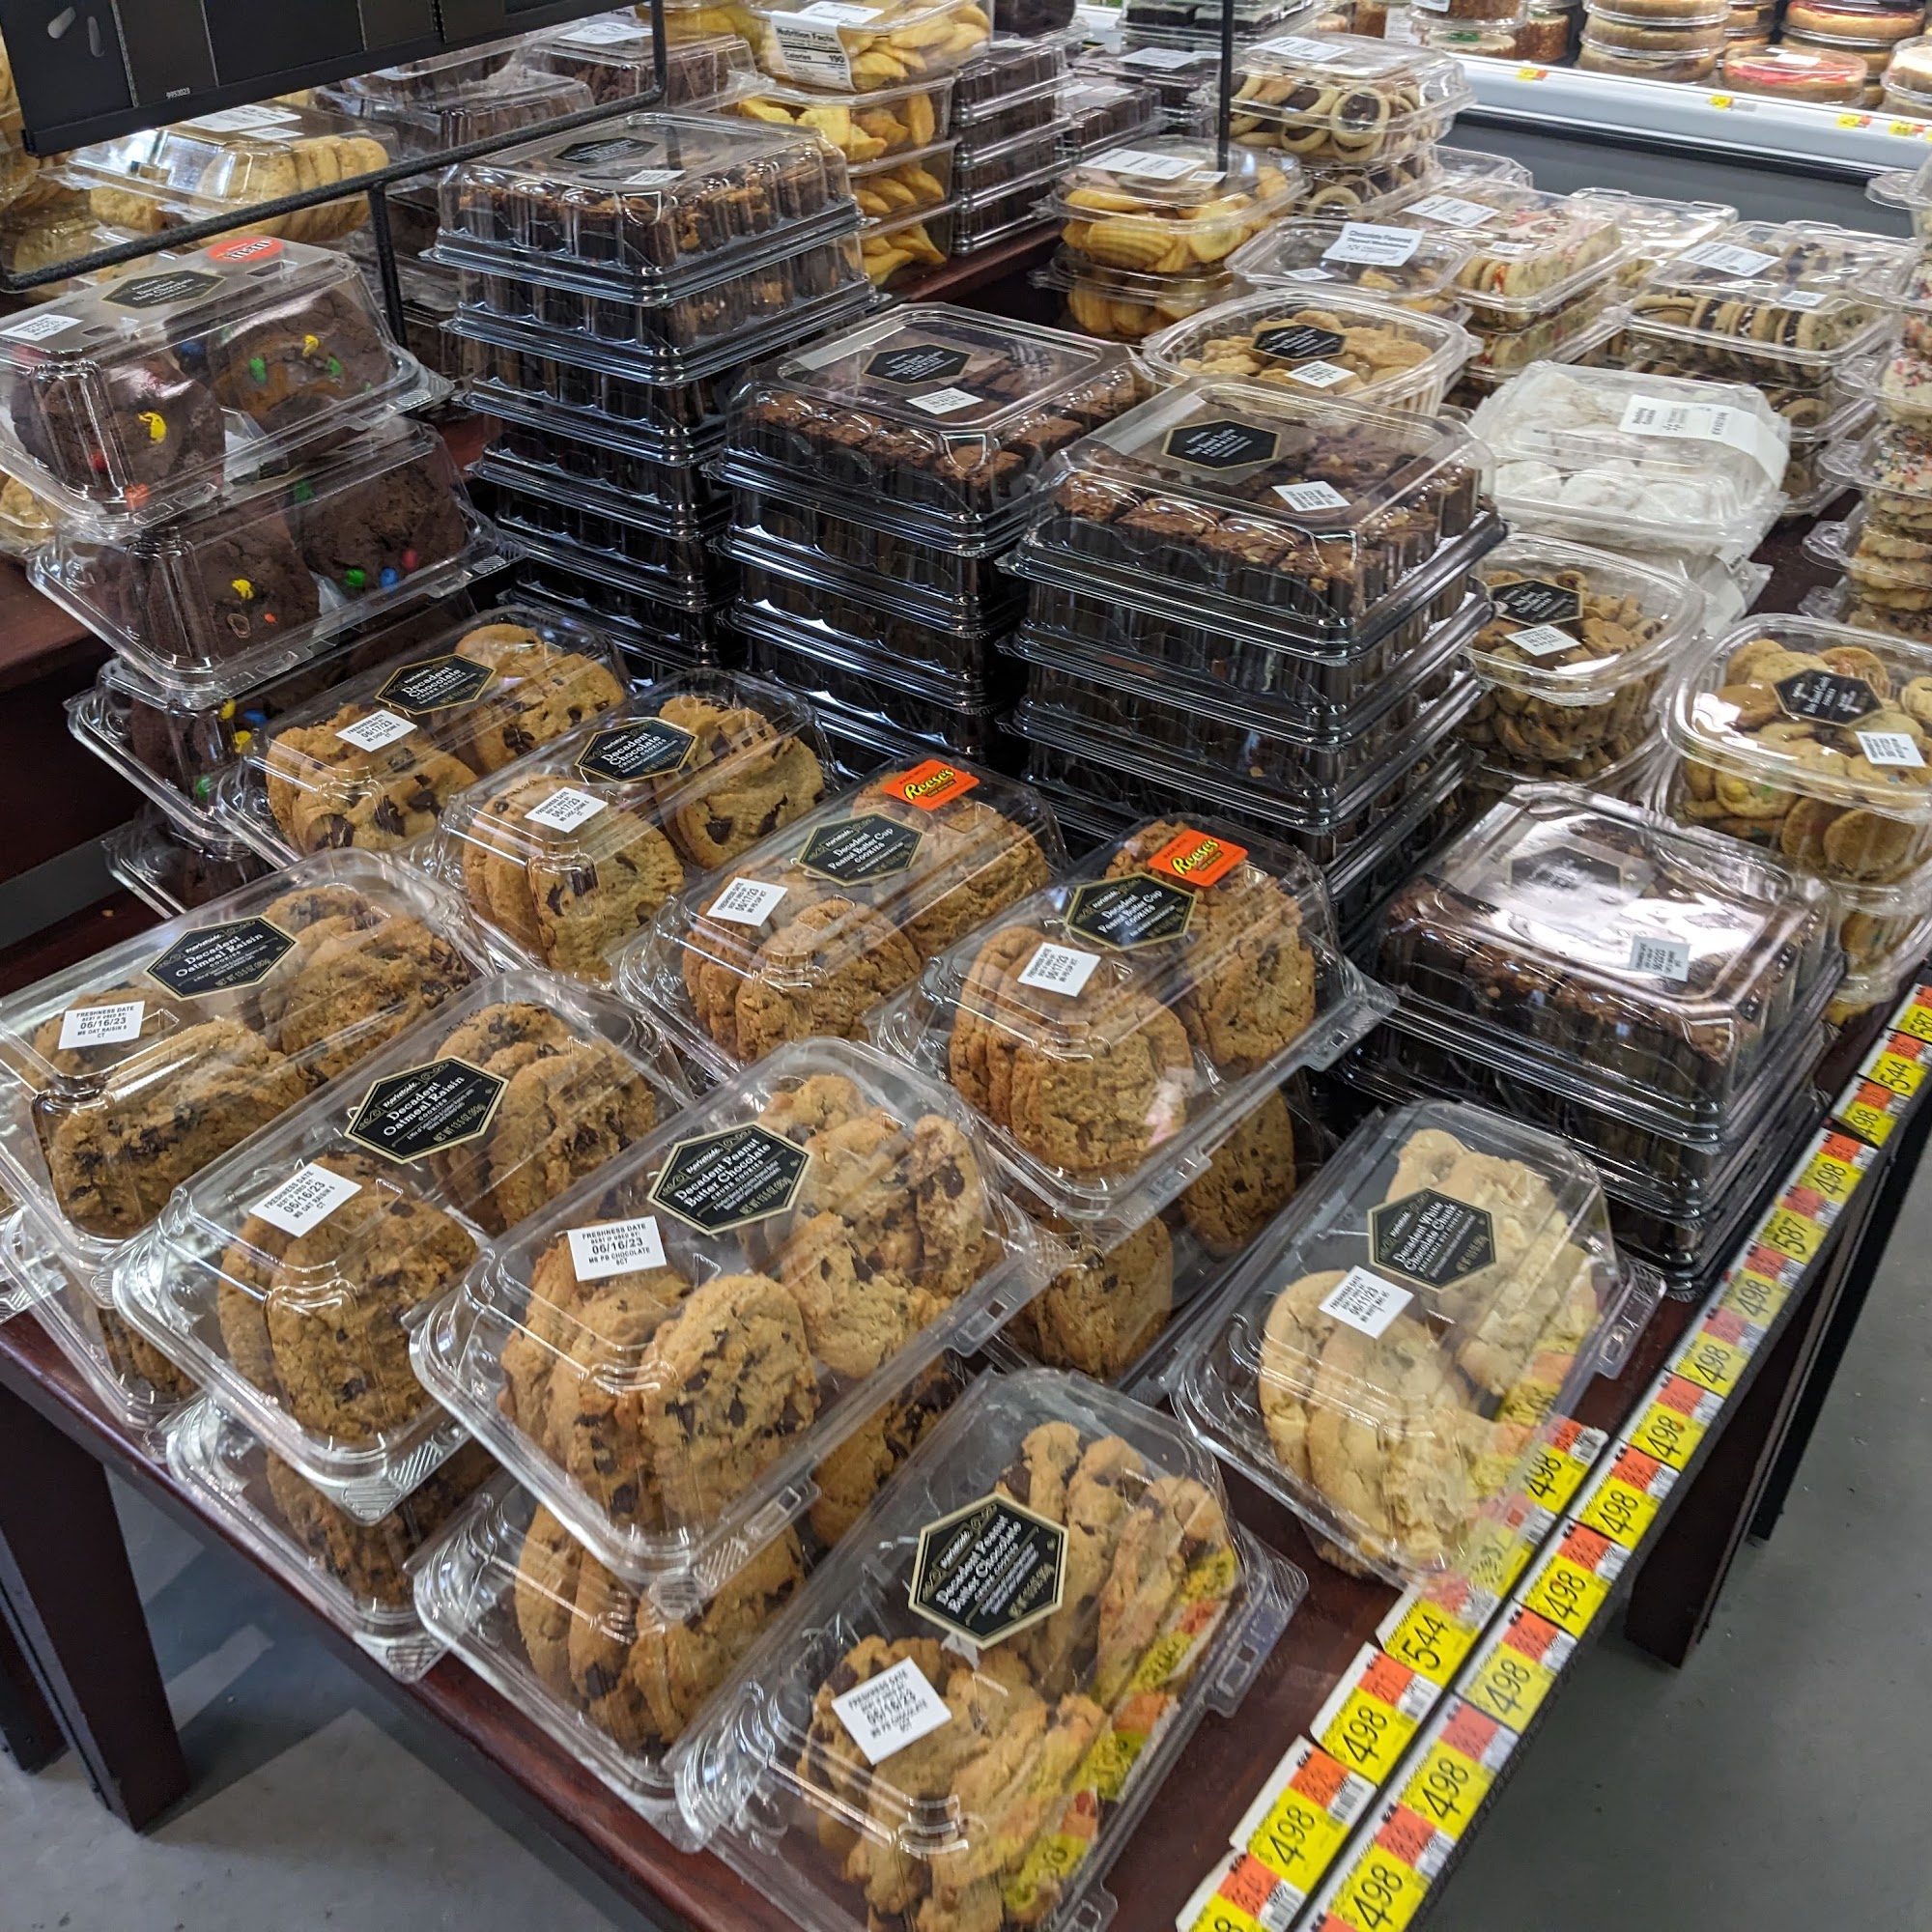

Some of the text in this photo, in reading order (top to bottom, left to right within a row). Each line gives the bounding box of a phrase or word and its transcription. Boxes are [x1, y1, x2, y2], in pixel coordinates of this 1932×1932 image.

[400, 666, 453, 694] Decadent
[407, 668, 463, 697] Chocolate
[599, 731, 653, 761] Decadent
[608, 734, 663, 765] Chocolate
[904, 768, 956, 800] Reese's
[826, 851, 858, 869] Peanut
[850, 837, 879, 854] Butter
[870, 826, 897, 841] Cup
[831, 832, 872, 856] Decadent
[852, 841, 887, 864] COOKIES
[1171, 838, 1220, 876] Reese's
[1095, 913, 1126, 933] Peanut
[1138, 888, 1166, 904] Cup
[1098, 893, 1140, 919] Decadent
[173, 950, 227, 978] Oatmeal
[224, 931, 265, 952] Raisin
[182, 934, 242, 965] Decadent
[75, 1008, 115, 1017] FRESHNESS
[79, 1016, 127, 1029] 06/16/23
[380, 1074, 467, 1137] Oatmeal Raisin
[384, 1080, 442, 1121] Decadent
[671, 1162, 726, 1201] Decadent
[720, 1137, 761, 1166] Peanut
[682, 1179, 723, 1208] Butter
[714, 1142, 773, 1183] Chocolate
[732, 1158, 765, 1181] COOKIES
[263, 1170, 314, 1208] FRESHNESS DATE
[281, 1179, 327, 1213] 06/16/23
[314, 1201, 327, 1209] CT
[582, 1222, 646, 1239] FRESHNESS DATE
[590, 1236, 643, 1255] 06/16/23
[1391, 1199, 1444, 1263] Decadent White
[1401, 1229, 1439, 1271] Chocolate
[1430, 1202, 1458, 1231] Chunk
[611, 1246, 650, 1260] CHOCOLATE
[933, 1548, 983, 1605] Decadent
[972, 1513, 1010, 1554] Peanut
[945, 1573, 983, 1614] Butter
[972, 1519, 1025, 1579] Chocolate
